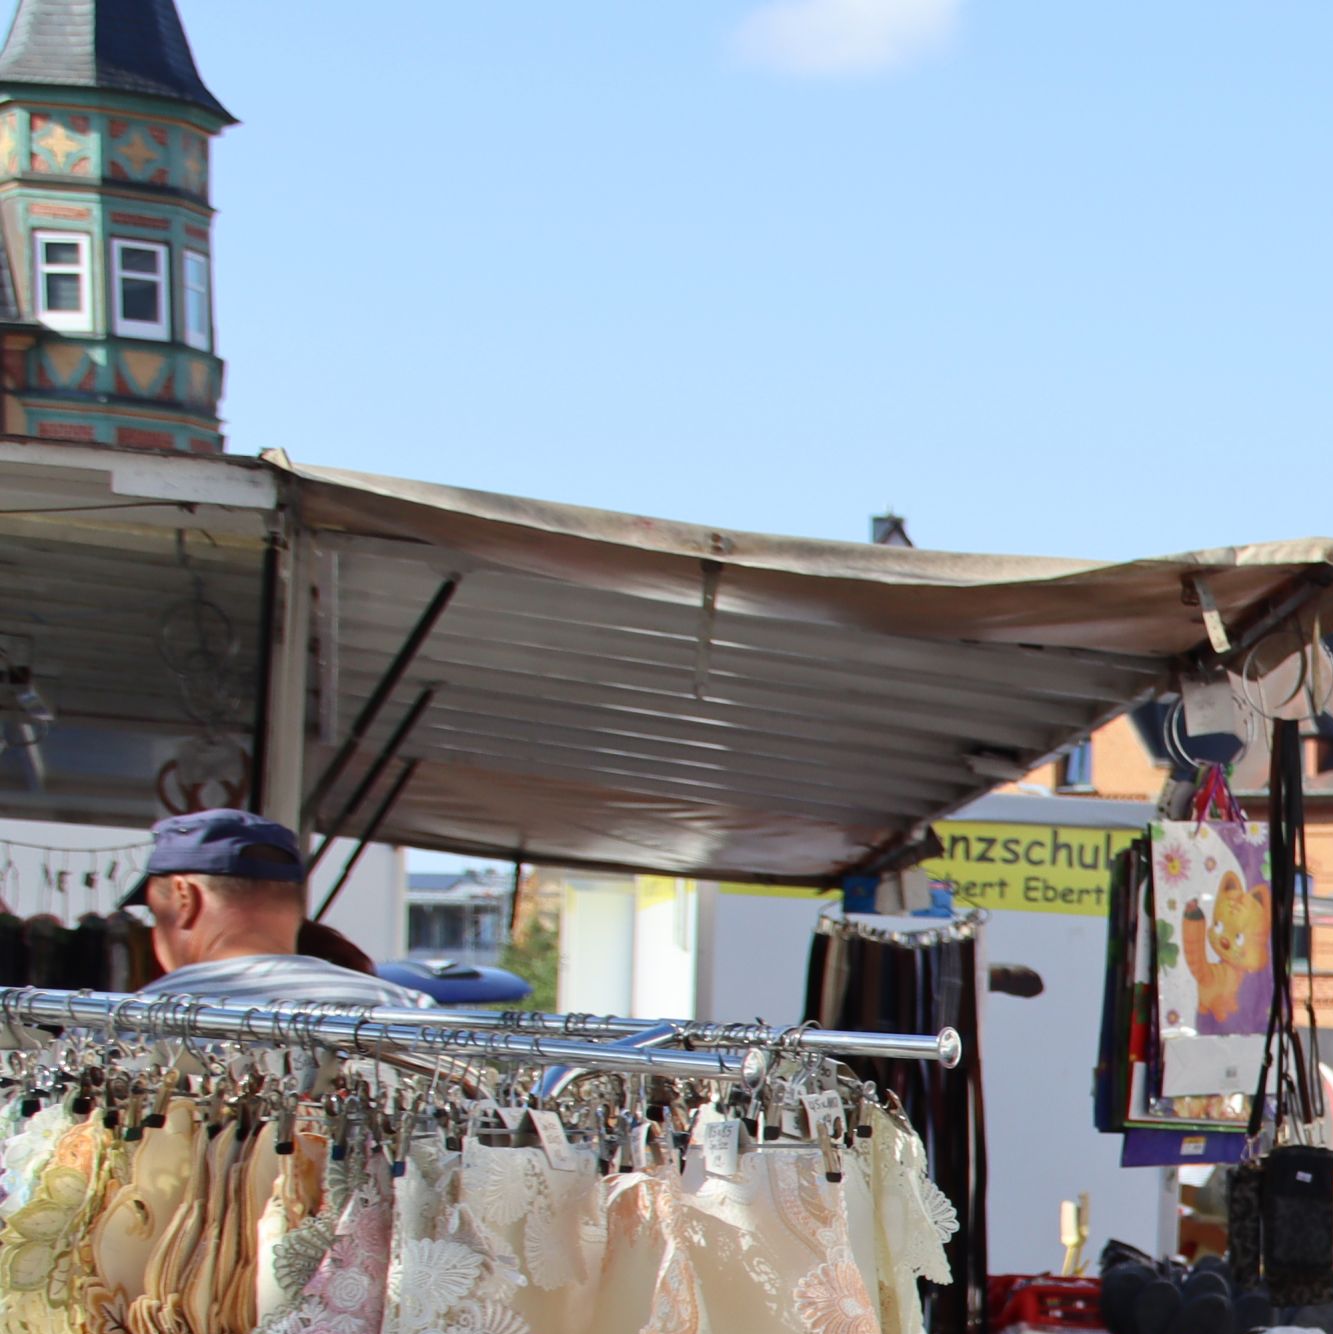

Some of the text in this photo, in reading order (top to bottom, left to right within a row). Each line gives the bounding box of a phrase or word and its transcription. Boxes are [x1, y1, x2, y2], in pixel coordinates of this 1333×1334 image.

[946, 827, 1116, 871] nzschul
[944, 873, 1104, 905] bert Ebert
